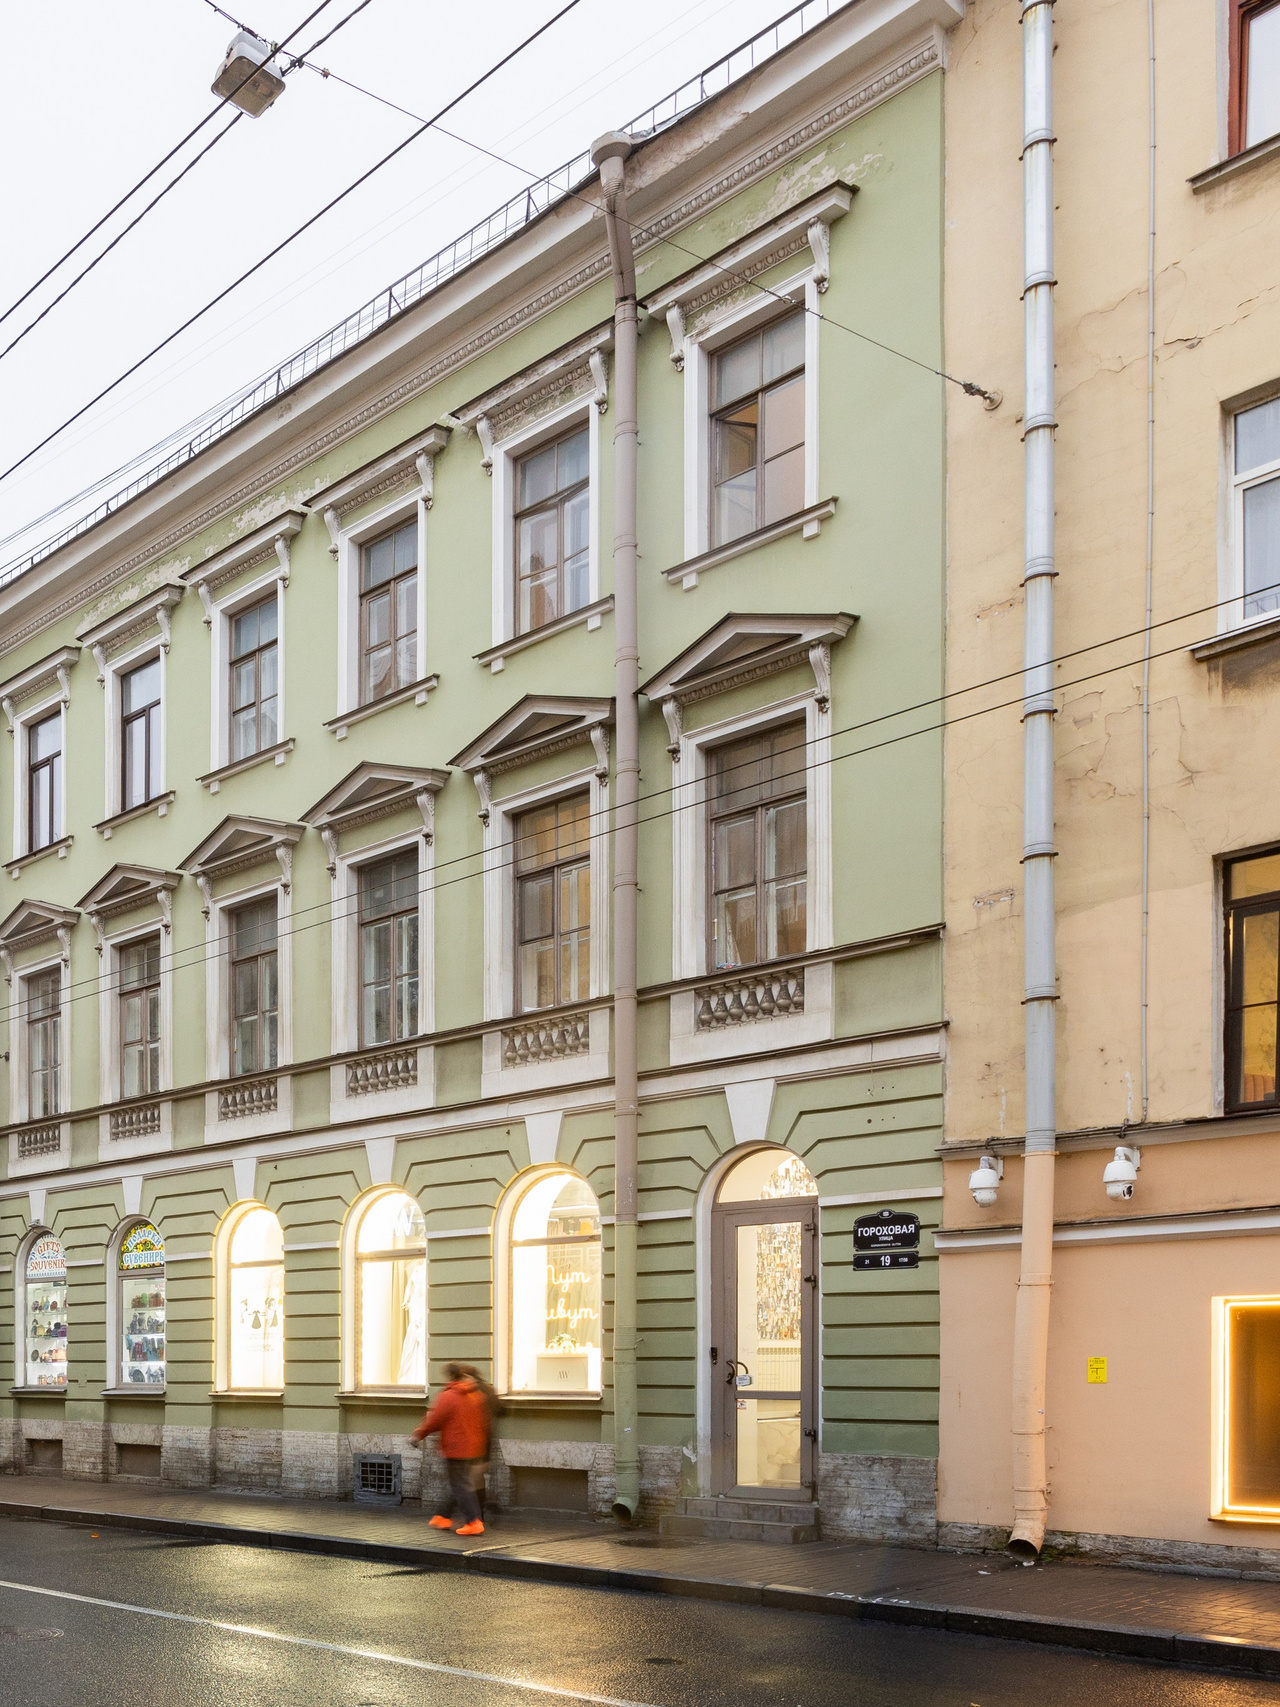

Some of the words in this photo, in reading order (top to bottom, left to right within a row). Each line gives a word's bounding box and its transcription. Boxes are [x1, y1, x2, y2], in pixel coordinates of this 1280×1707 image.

[858, 1224, 915, 1237] ГОРОХОВАЯ
[127, 1229, 162, 1248] ПОДАРКИ
[37, 1241, 61, 1255] GIFTS
[30, 1259, 67, 1271] SOUVENIR
[880, 1255, 891, 1266] 19
[544, 1297, 599, 1329] ивут
